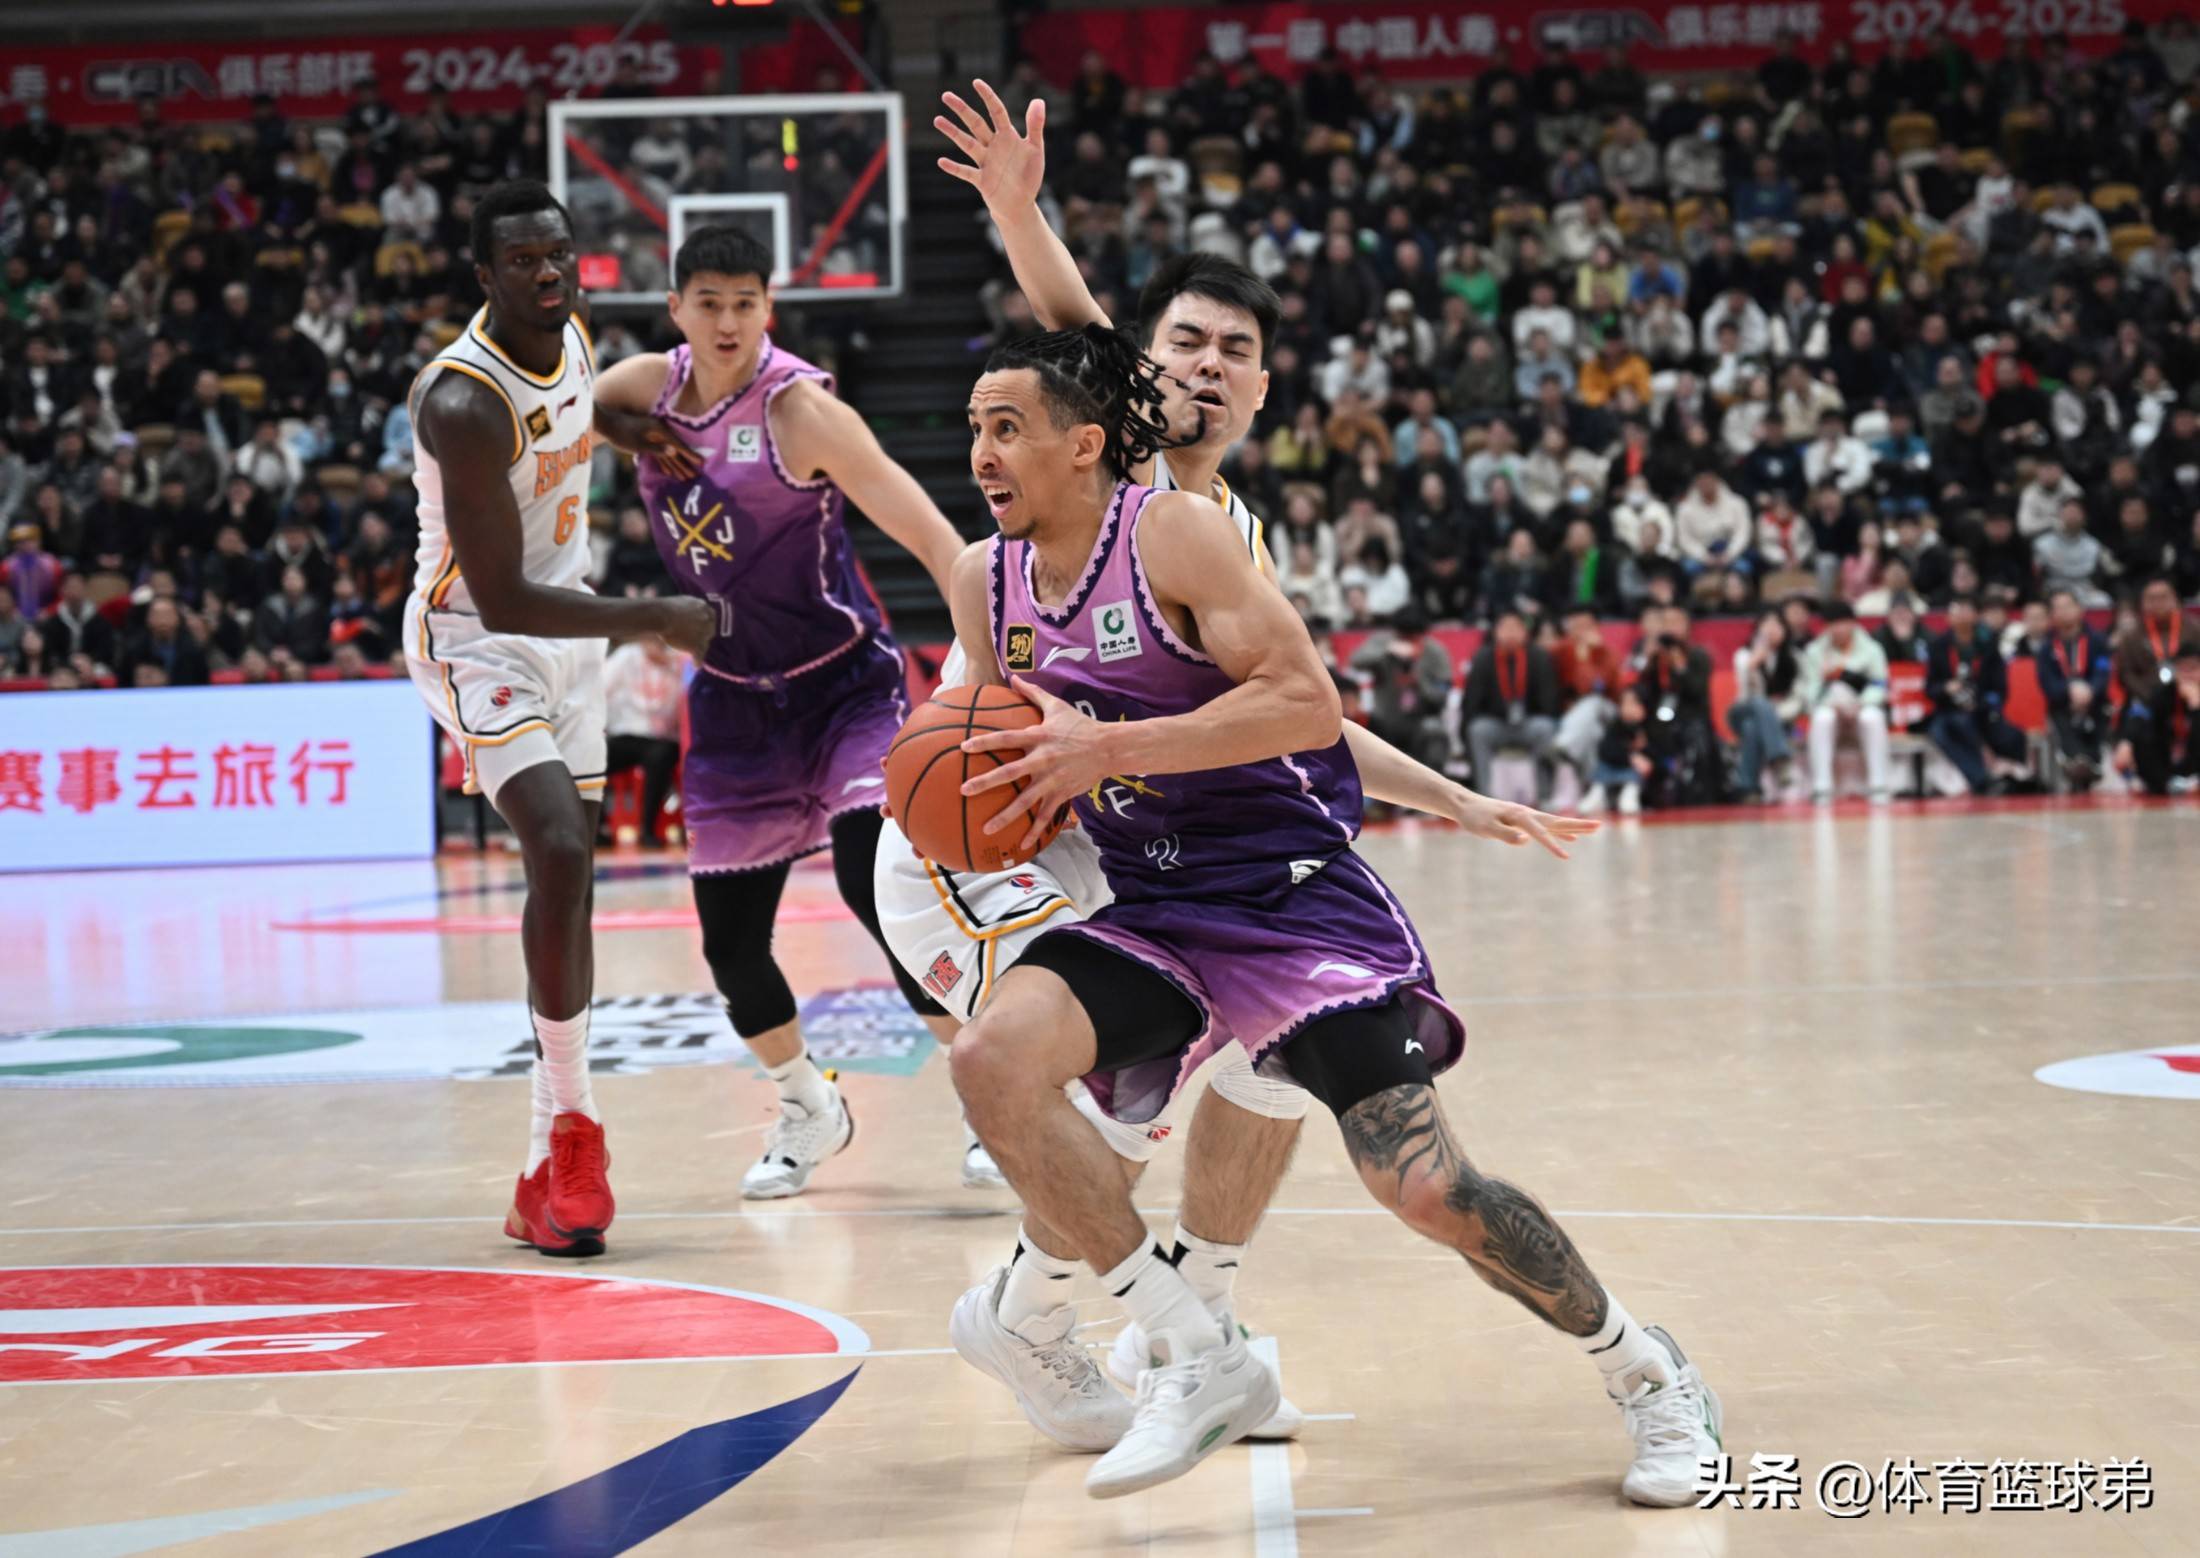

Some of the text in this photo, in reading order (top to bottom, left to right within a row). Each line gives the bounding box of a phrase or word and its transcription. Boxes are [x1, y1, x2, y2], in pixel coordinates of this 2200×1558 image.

[554, 494, 580, 546] 6
[716, 515, 735, 544] J
[690, 546, 709, 576] F
[1100, 636, 1136, 651] 中国人寿
[1102, 645, 1137, 658] CHINA LIFE
[1145, 832, 1185, 872] 2
